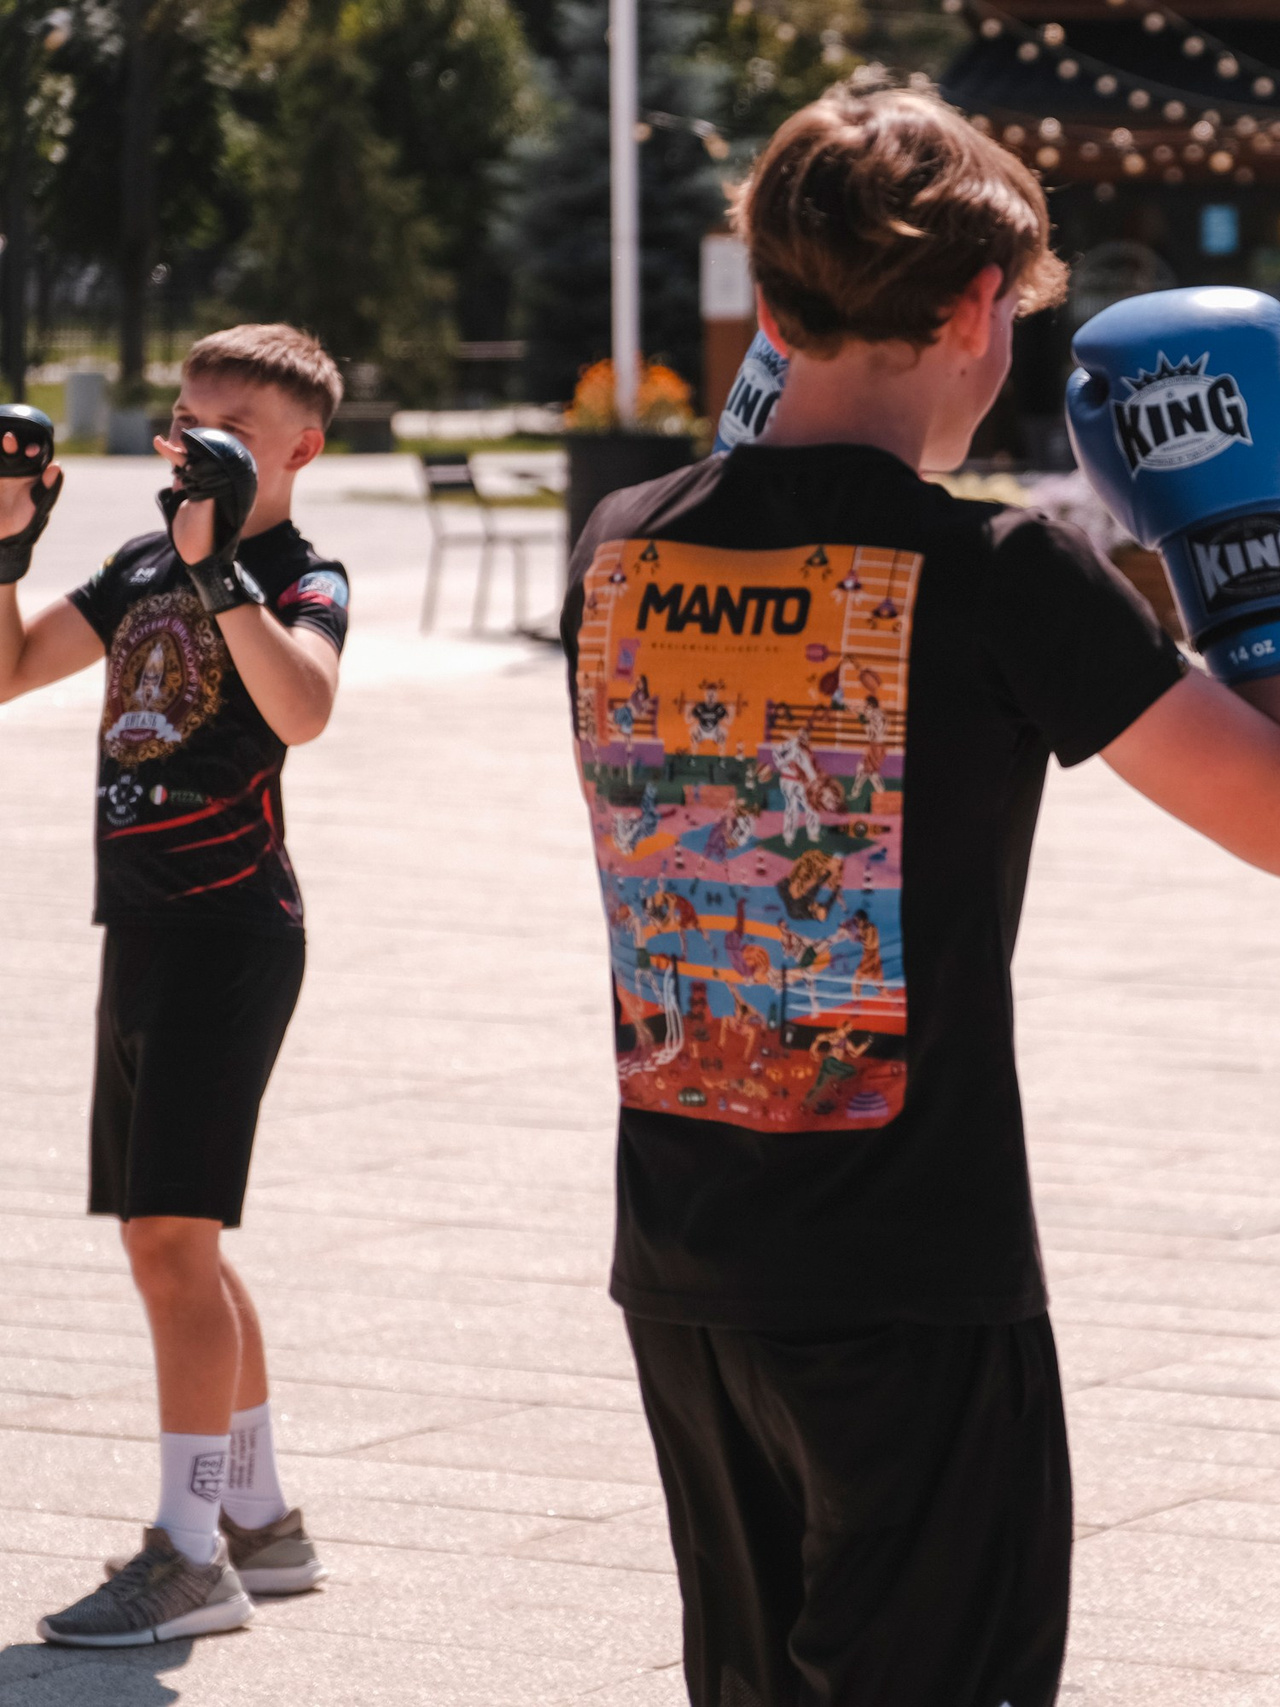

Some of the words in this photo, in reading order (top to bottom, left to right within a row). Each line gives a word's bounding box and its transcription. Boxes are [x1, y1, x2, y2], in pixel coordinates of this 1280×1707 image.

[1113, 377, 1249, 470] KING
[635, 582, 812, 636] MANTO
[1228, 645, 1250, 666] 14
